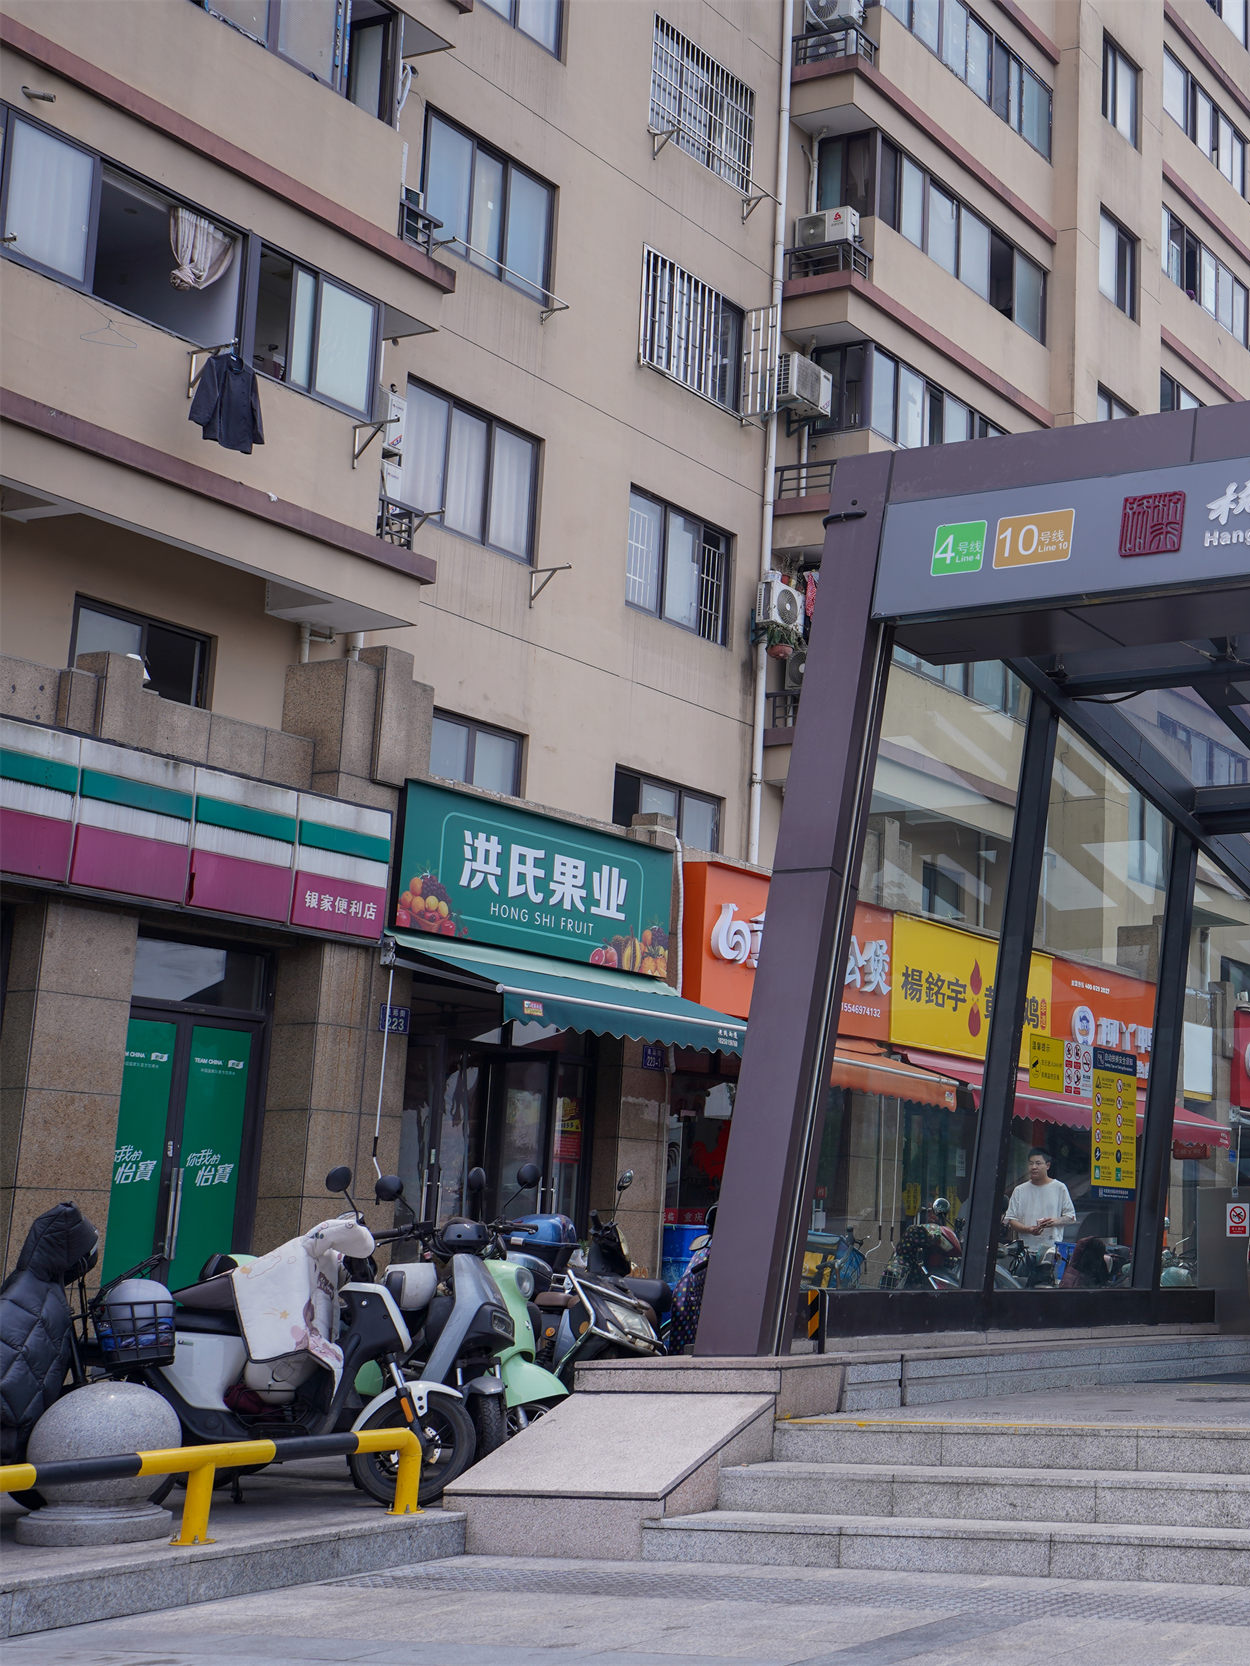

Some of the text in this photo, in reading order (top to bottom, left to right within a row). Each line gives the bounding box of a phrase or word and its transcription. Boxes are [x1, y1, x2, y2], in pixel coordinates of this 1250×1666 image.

[955, 553, 981, 563] Line 4
[1037, 541, 1068, 553] Line 10
[459, 830, 628, 921] 洪氏果业
[304, 890, 377, 921] 银家便利店
[490, 902, 594, 936] HONG SHI FRUIT
[901, 964, 967, 1013] 楊銘宇
[114, 1160, 157, 1184] 怡寶
[194, 1163, 234, 1187] 怡寶
